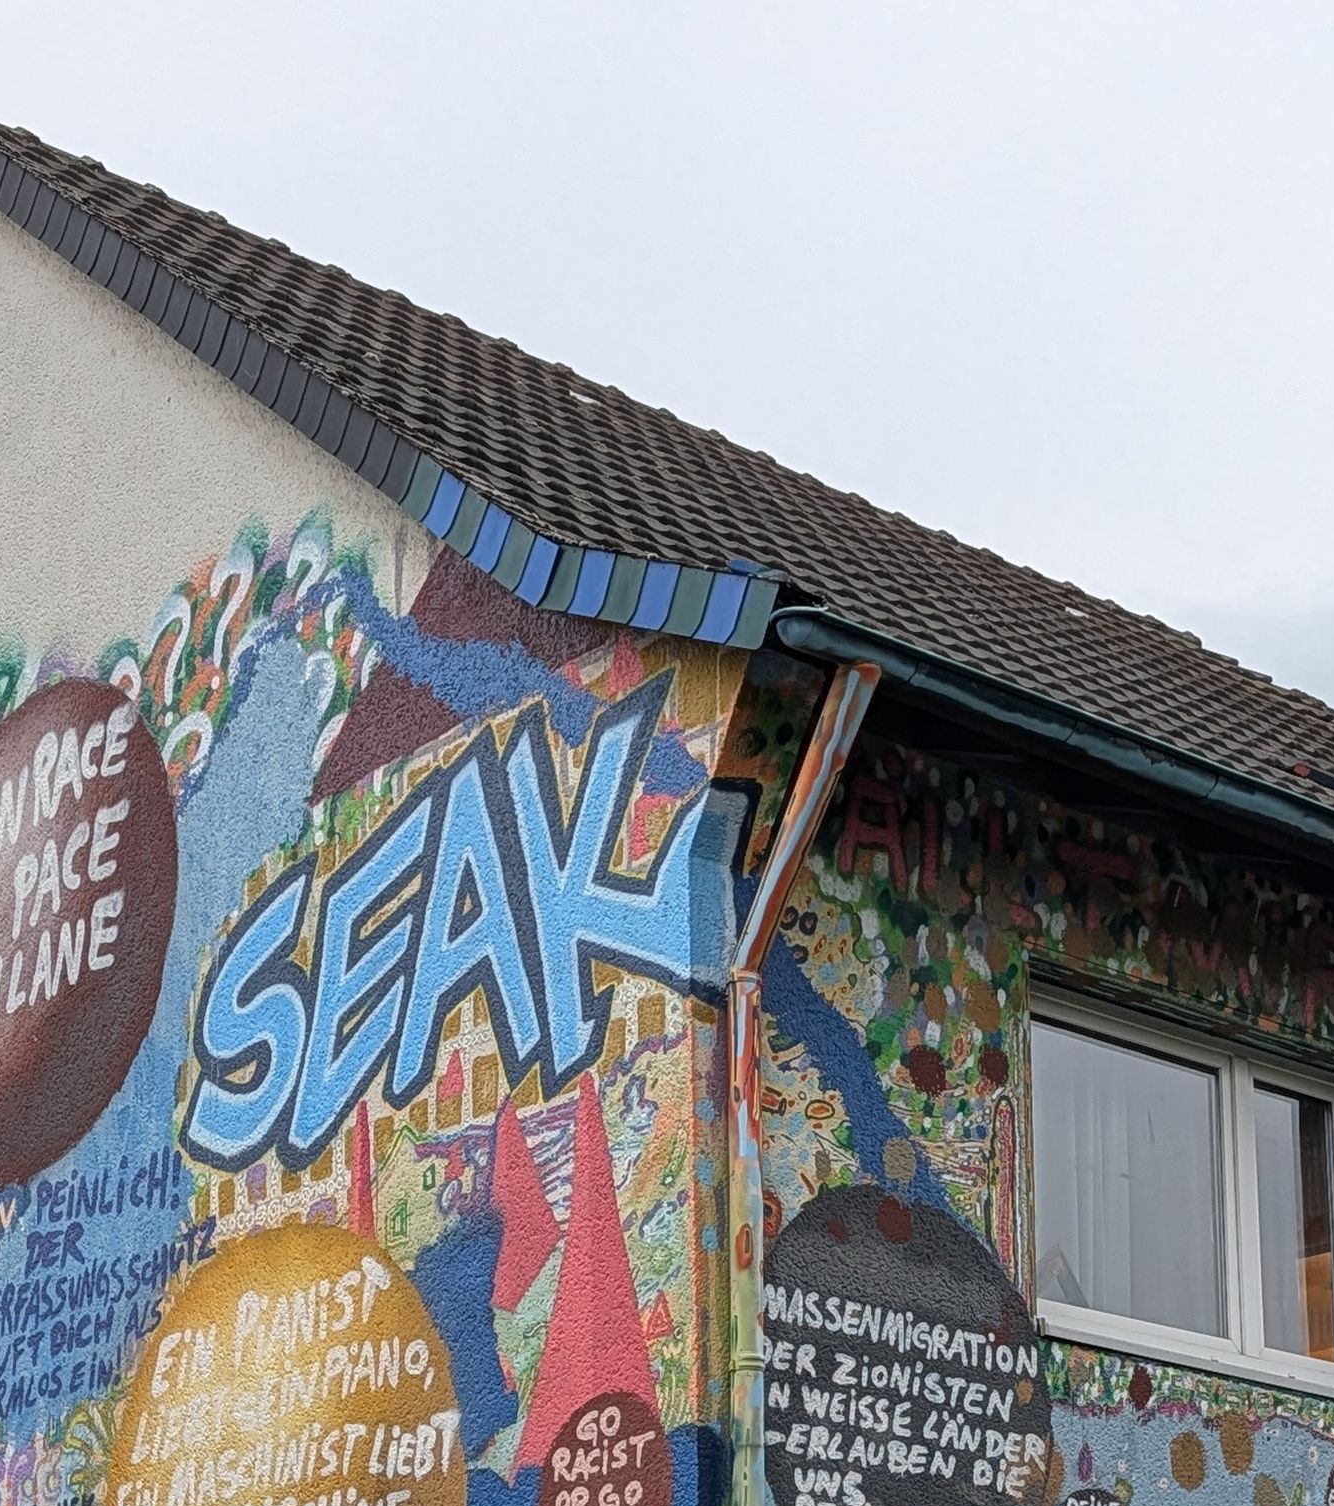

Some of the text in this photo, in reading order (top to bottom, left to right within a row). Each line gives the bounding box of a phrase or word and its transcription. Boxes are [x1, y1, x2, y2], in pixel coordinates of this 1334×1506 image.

[33, 701, 139, 826] RACE
[13, 799, 129, 939] PACE
[6, 890, 124, 1014] LANE
[35, 1146, 182, 1224] PEINLICH!
[24, 1221, 85, 1278] DER
[49, 1305, 115, 1357] DICH
[125, 1297, 163, 1341] ALS
[151, 1256, 390, 1397] EIN PIANIST
[763, 1284, 1038, 1377] MASSENMIGRATION
[833, 1353, 1015, 1422] ZIONISTEN
[368, 1410, 462, 1481] LIEBT
[551, 1433, 655, 1482] RACIST
[577, 1407, 621, 1444] GO
[802, 1388, 1046, 1471] WEISSE LÄNDER
[973, 1458, 1032, 1498] DIE
